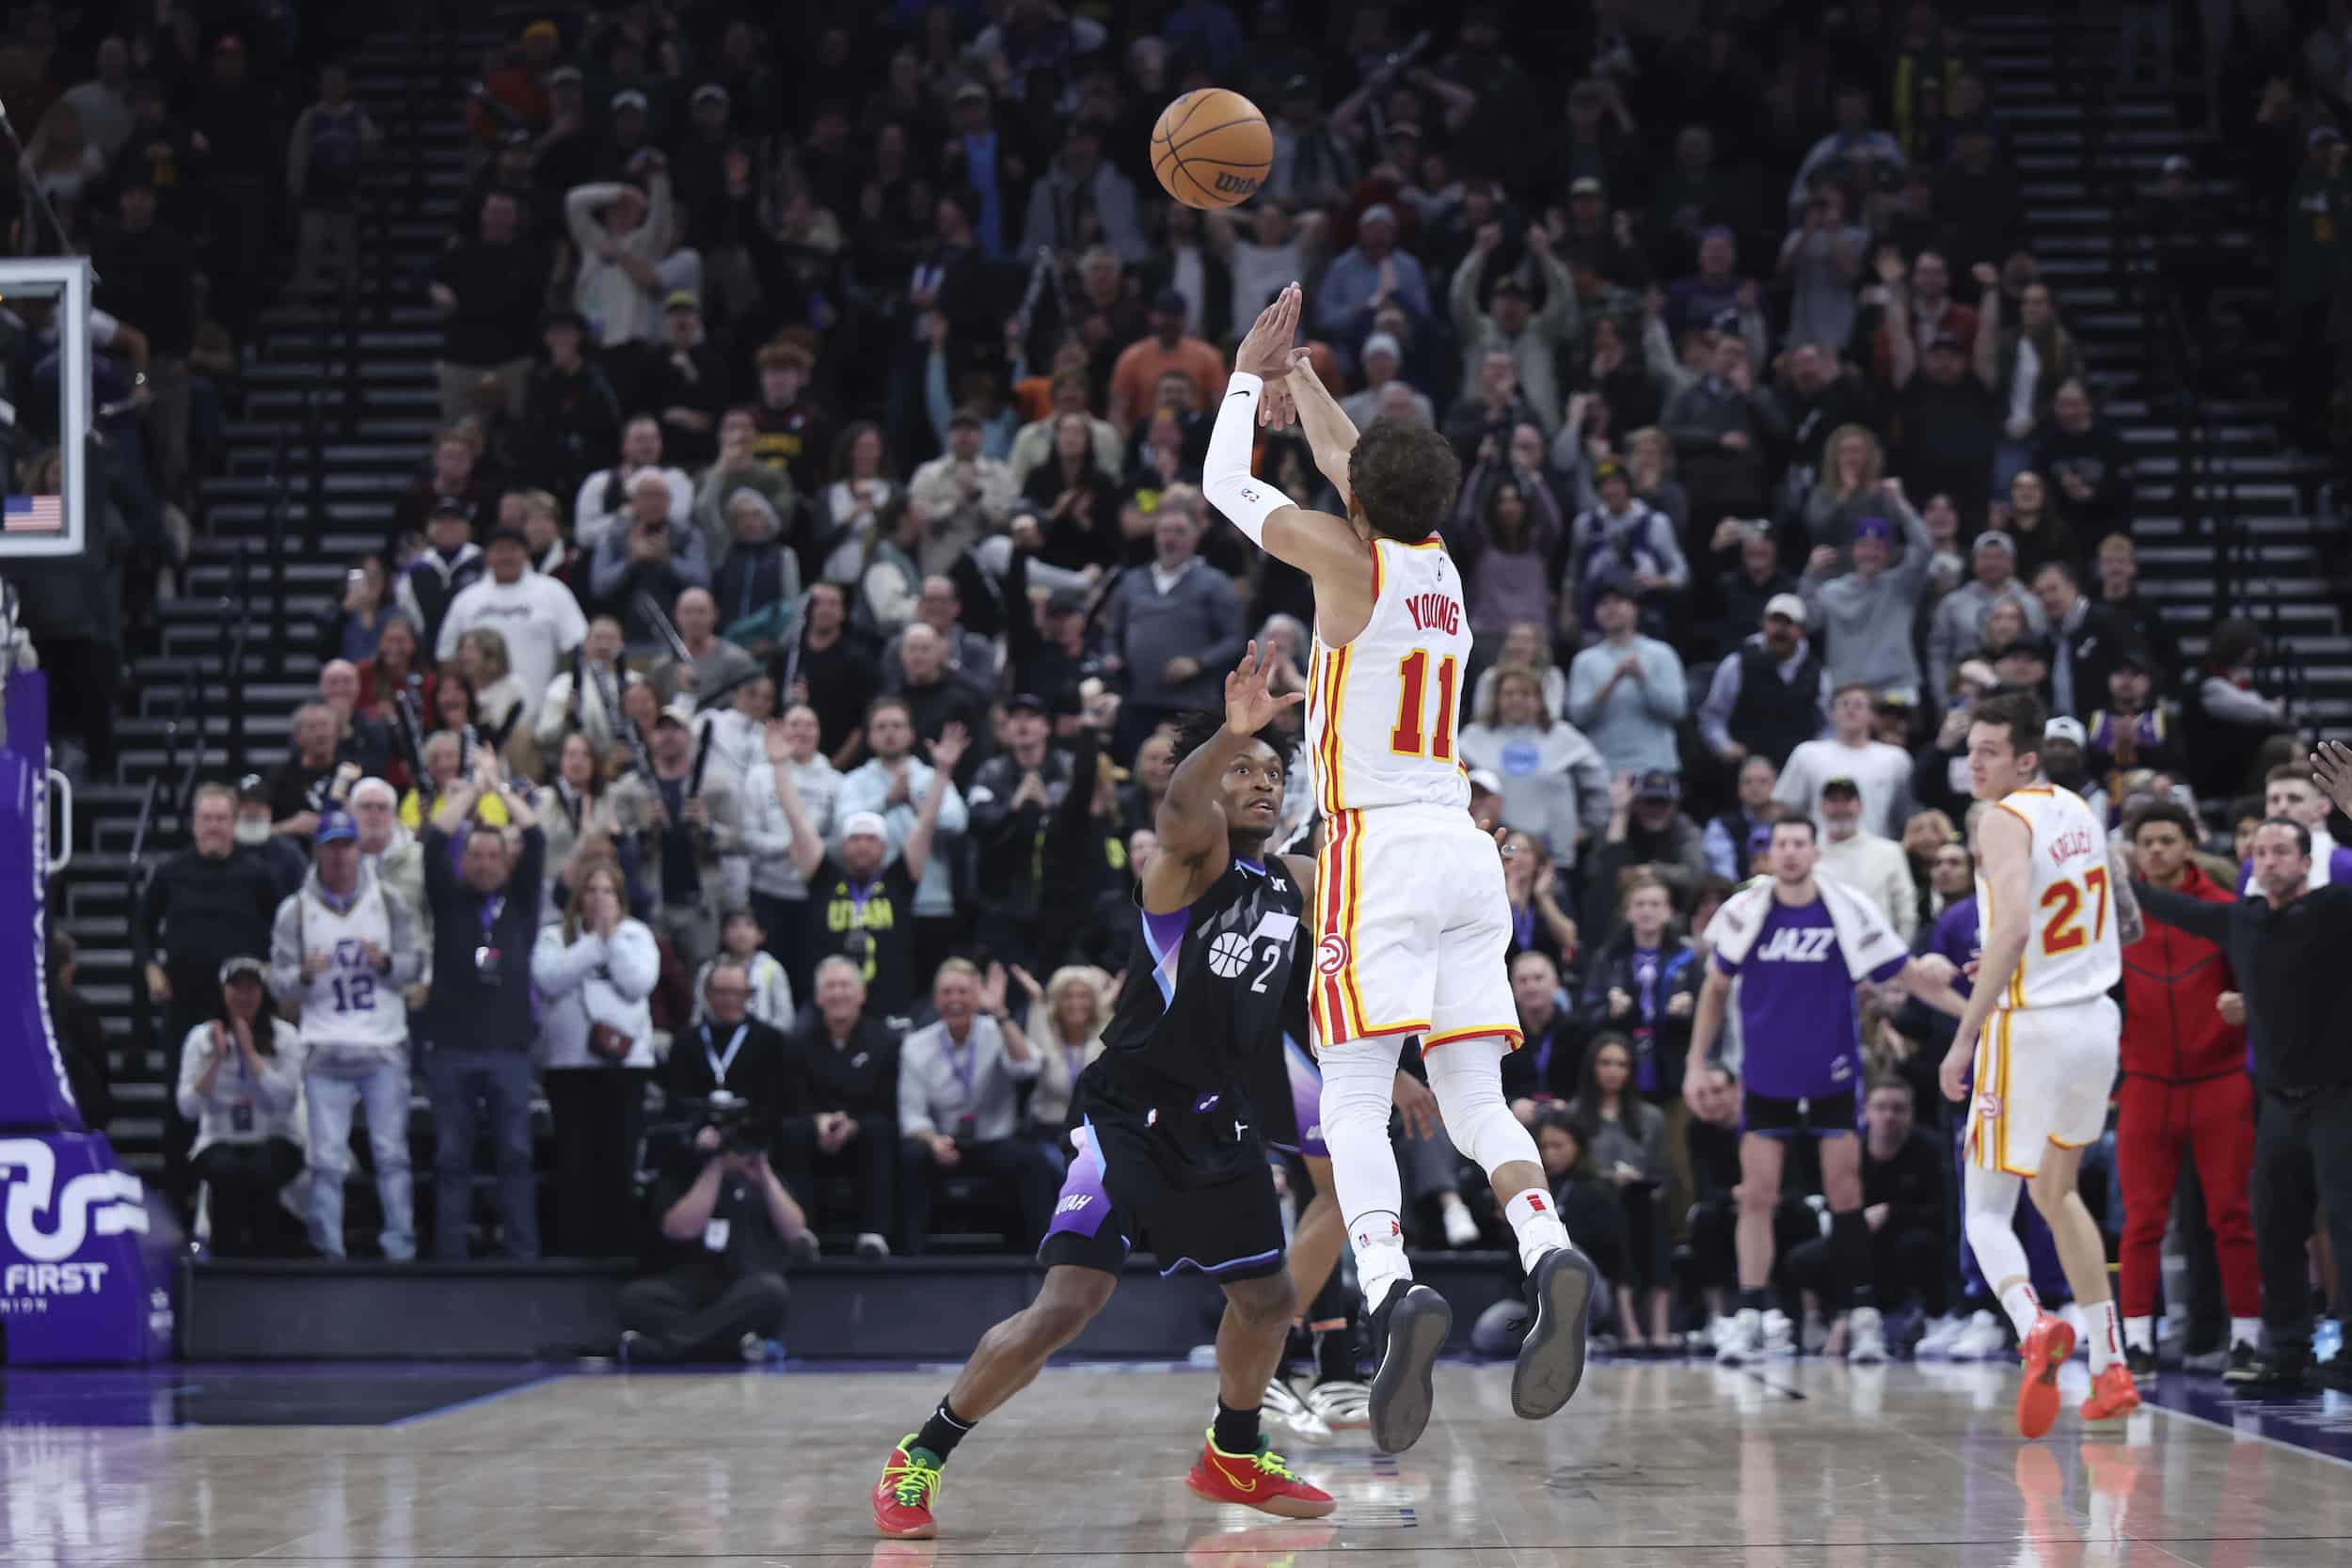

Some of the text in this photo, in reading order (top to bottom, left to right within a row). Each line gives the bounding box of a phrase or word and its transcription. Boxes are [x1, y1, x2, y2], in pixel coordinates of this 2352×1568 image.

[1405, 593, 1459, 636] YOUNG
[1391, 647, 1456, 763] 11
[2040, 863, 2107, 956] 27
[1757, 927, 1835, 962] JAZZ
[1250, 944, 1281, 994] 2
[332, 973, 375, 1013] 12
[5, 1262, 109, 1295] FIRST
